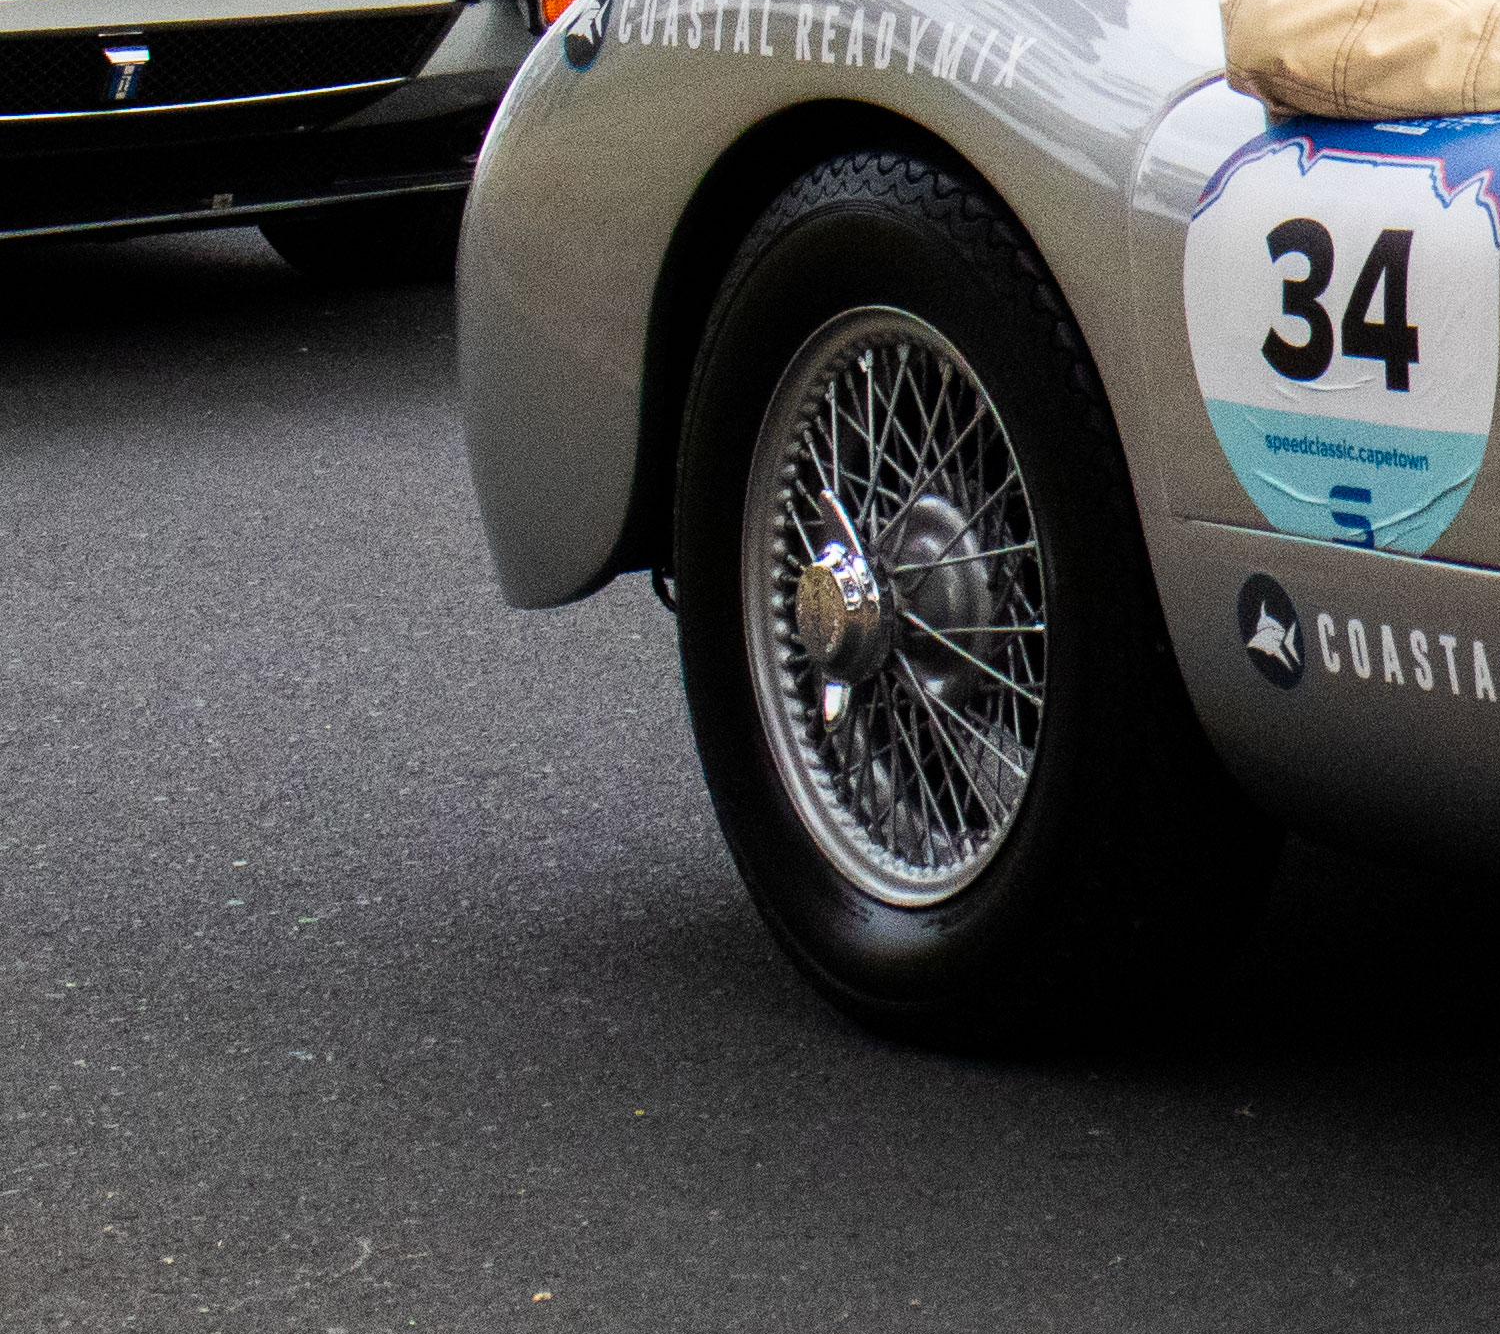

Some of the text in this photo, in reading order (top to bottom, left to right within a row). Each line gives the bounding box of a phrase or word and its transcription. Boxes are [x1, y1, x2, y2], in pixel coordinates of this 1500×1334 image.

[794, 3, 1037, 89] READYMIX
[1260, 217, 1420, 393] 34
[1265, 433, 1430, 472] speedclassic.capetown
